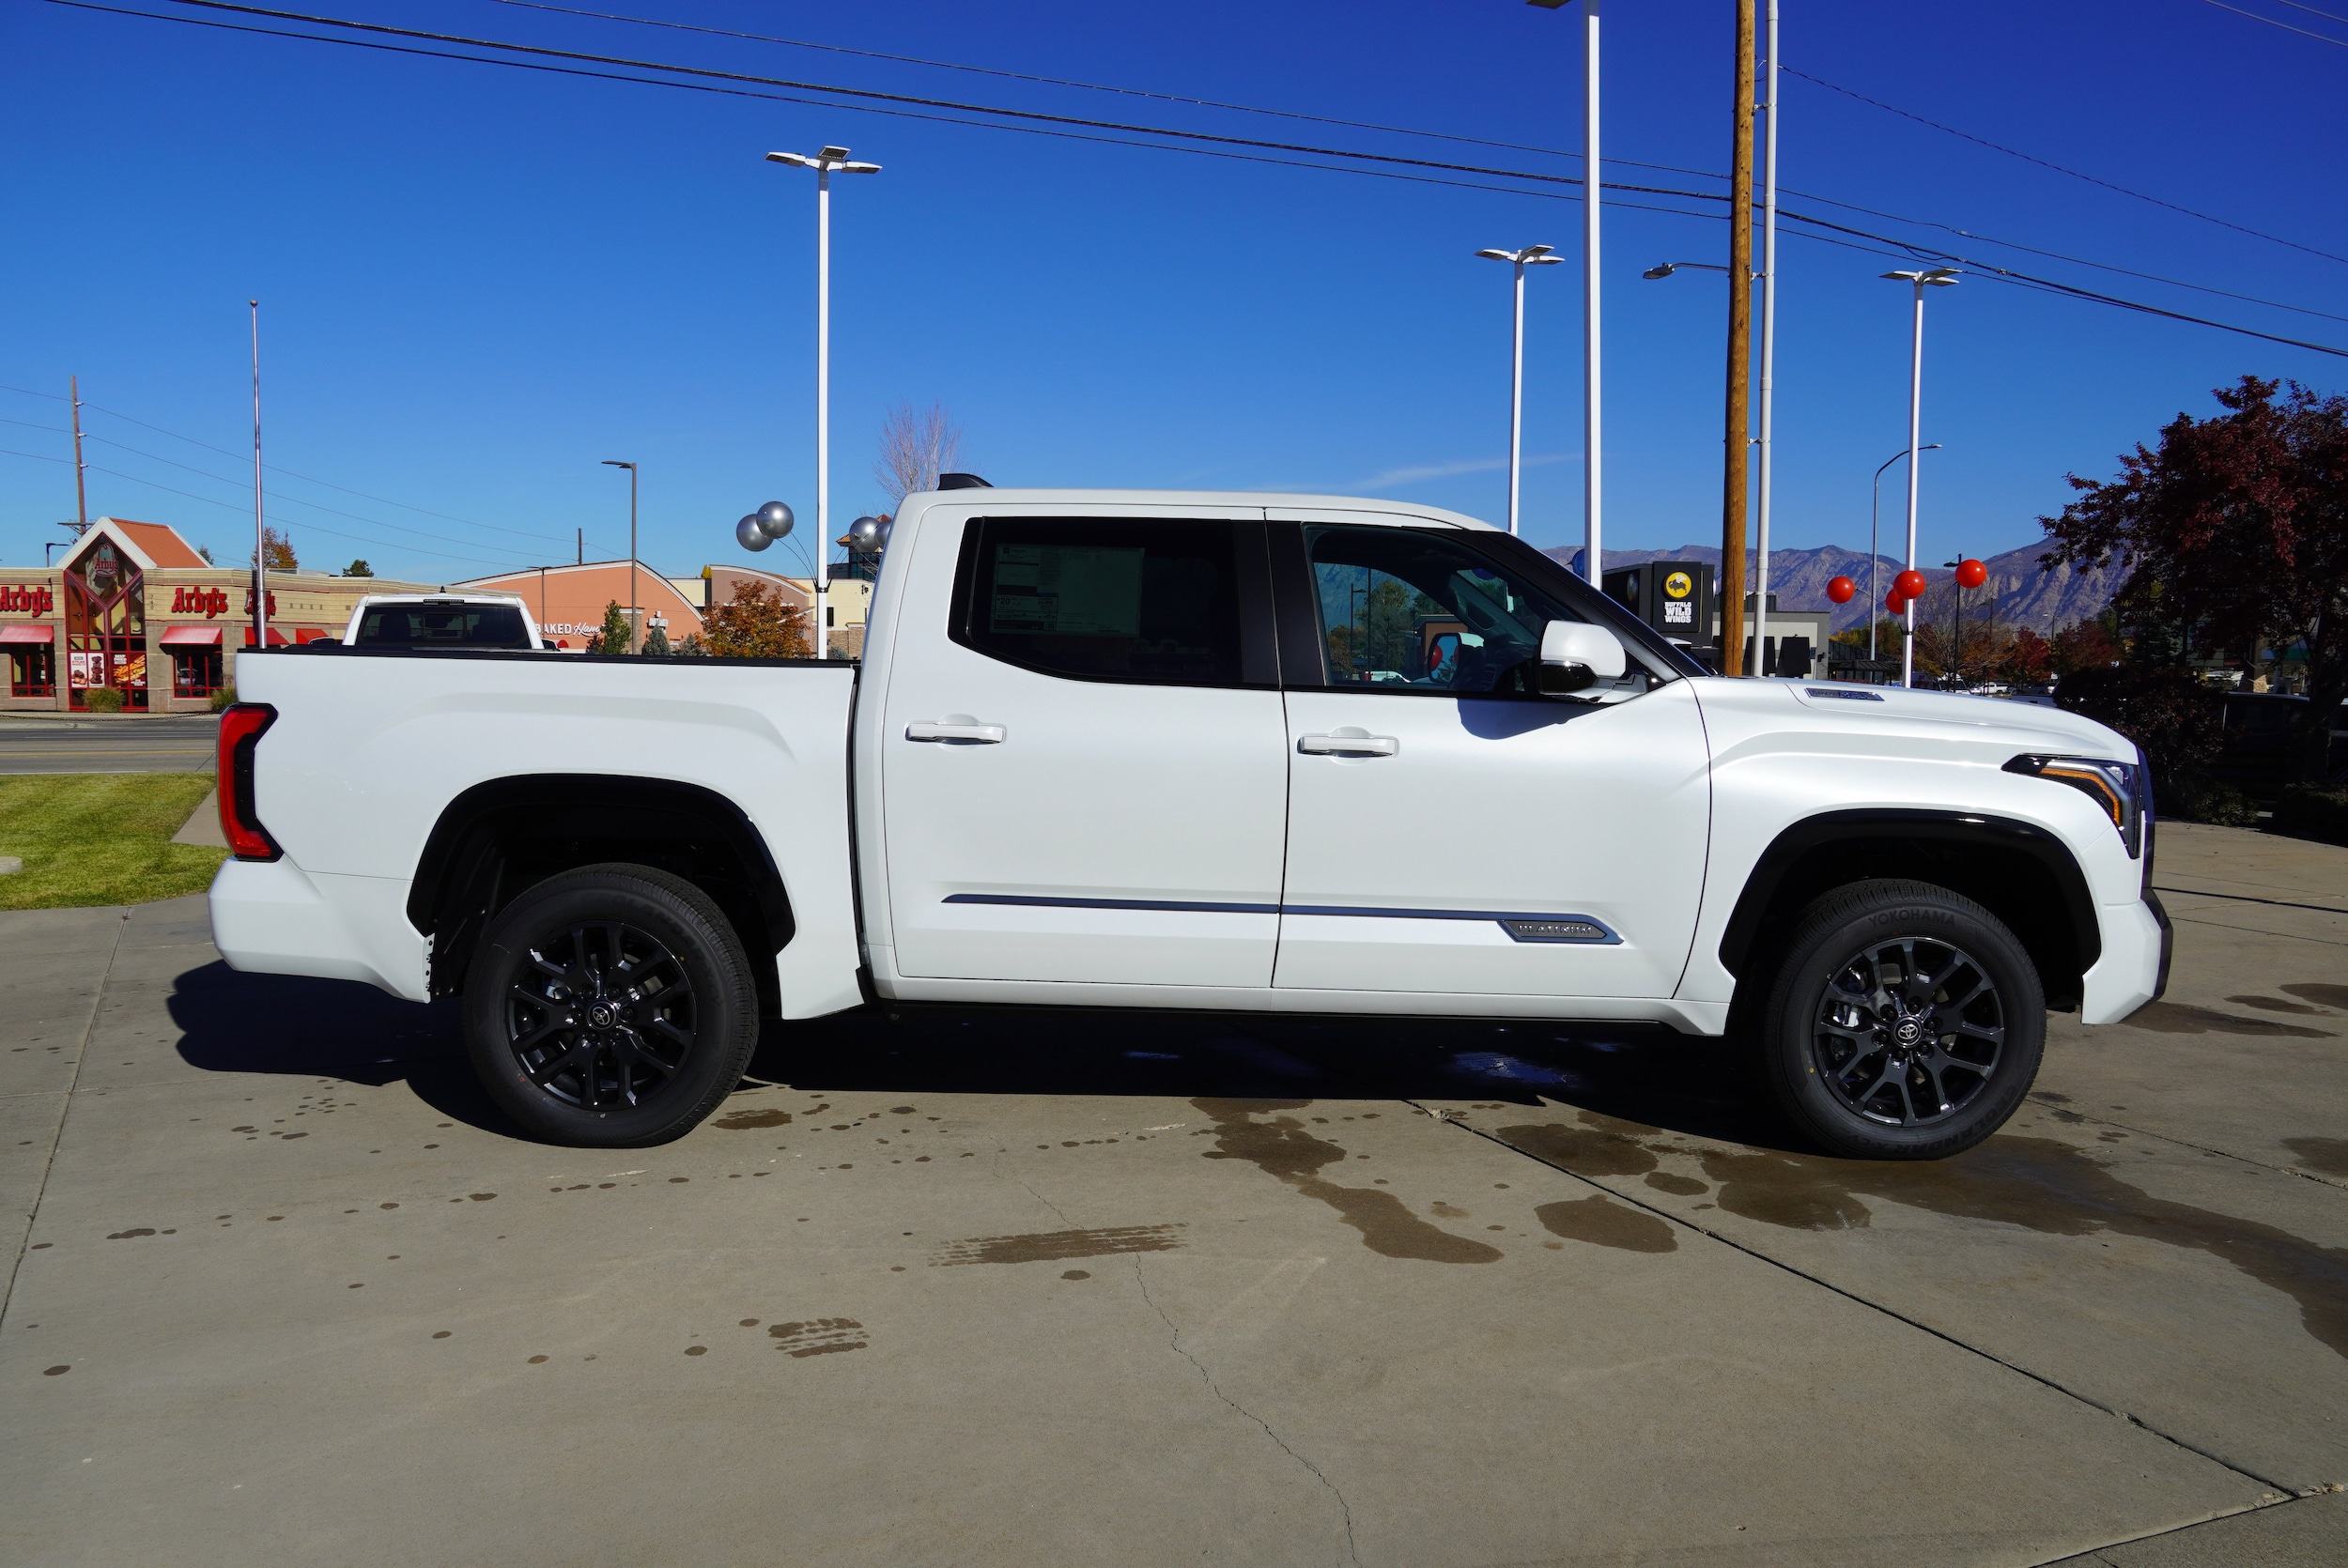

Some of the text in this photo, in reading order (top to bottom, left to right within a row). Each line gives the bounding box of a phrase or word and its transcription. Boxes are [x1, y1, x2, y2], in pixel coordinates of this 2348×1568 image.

[0, 585, 53, 617] Arby's
[171, 587, 228, 619] Arby's
[1664, 615, 1691, 623] WINGS
[1665, 607, 1691, 616] WILD
[1868, 908, 1955, 928] YOKOHAMA
[1519, 924, 1593, 934] PLATINUM
